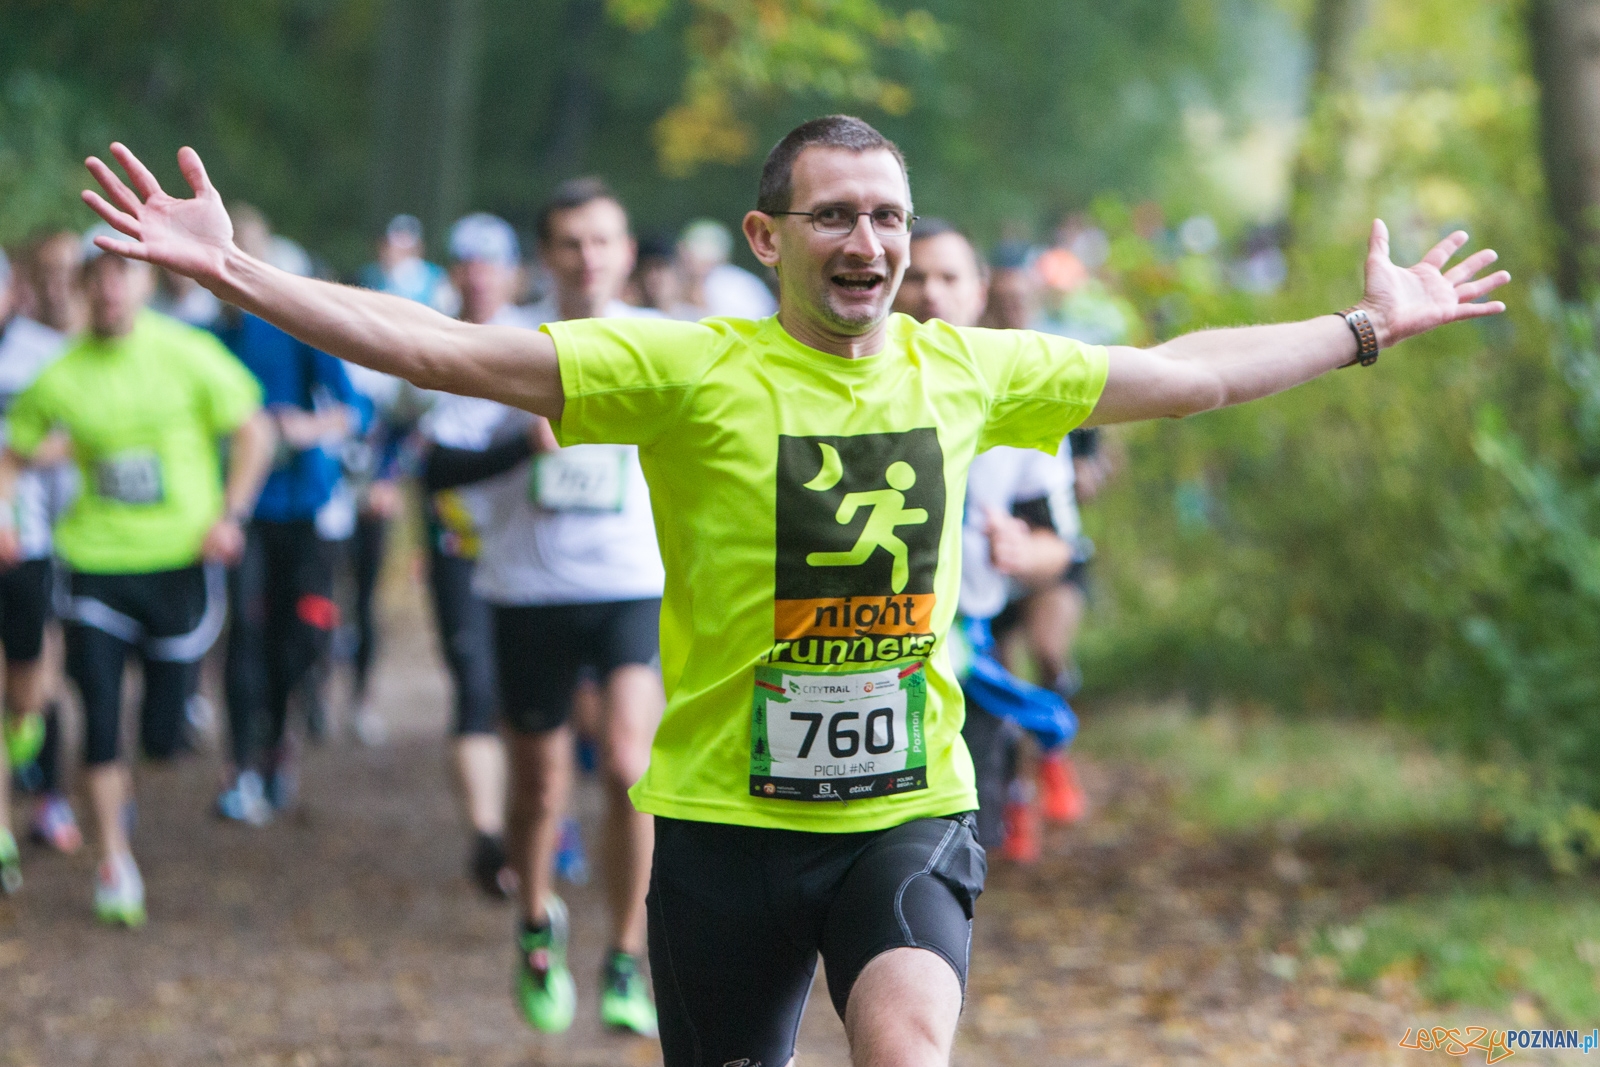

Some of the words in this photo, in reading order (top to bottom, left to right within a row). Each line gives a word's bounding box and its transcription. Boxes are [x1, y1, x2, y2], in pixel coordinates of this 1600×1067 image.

[814, 596, 917, 636] night
[769, 635, 934, 665] runners
[790, 707, 895, 759] 760
[912, 710, 921, 754] Poznań
[813, 764, 846, 777] PICIU
[849, 761, 875, 774] #NR
